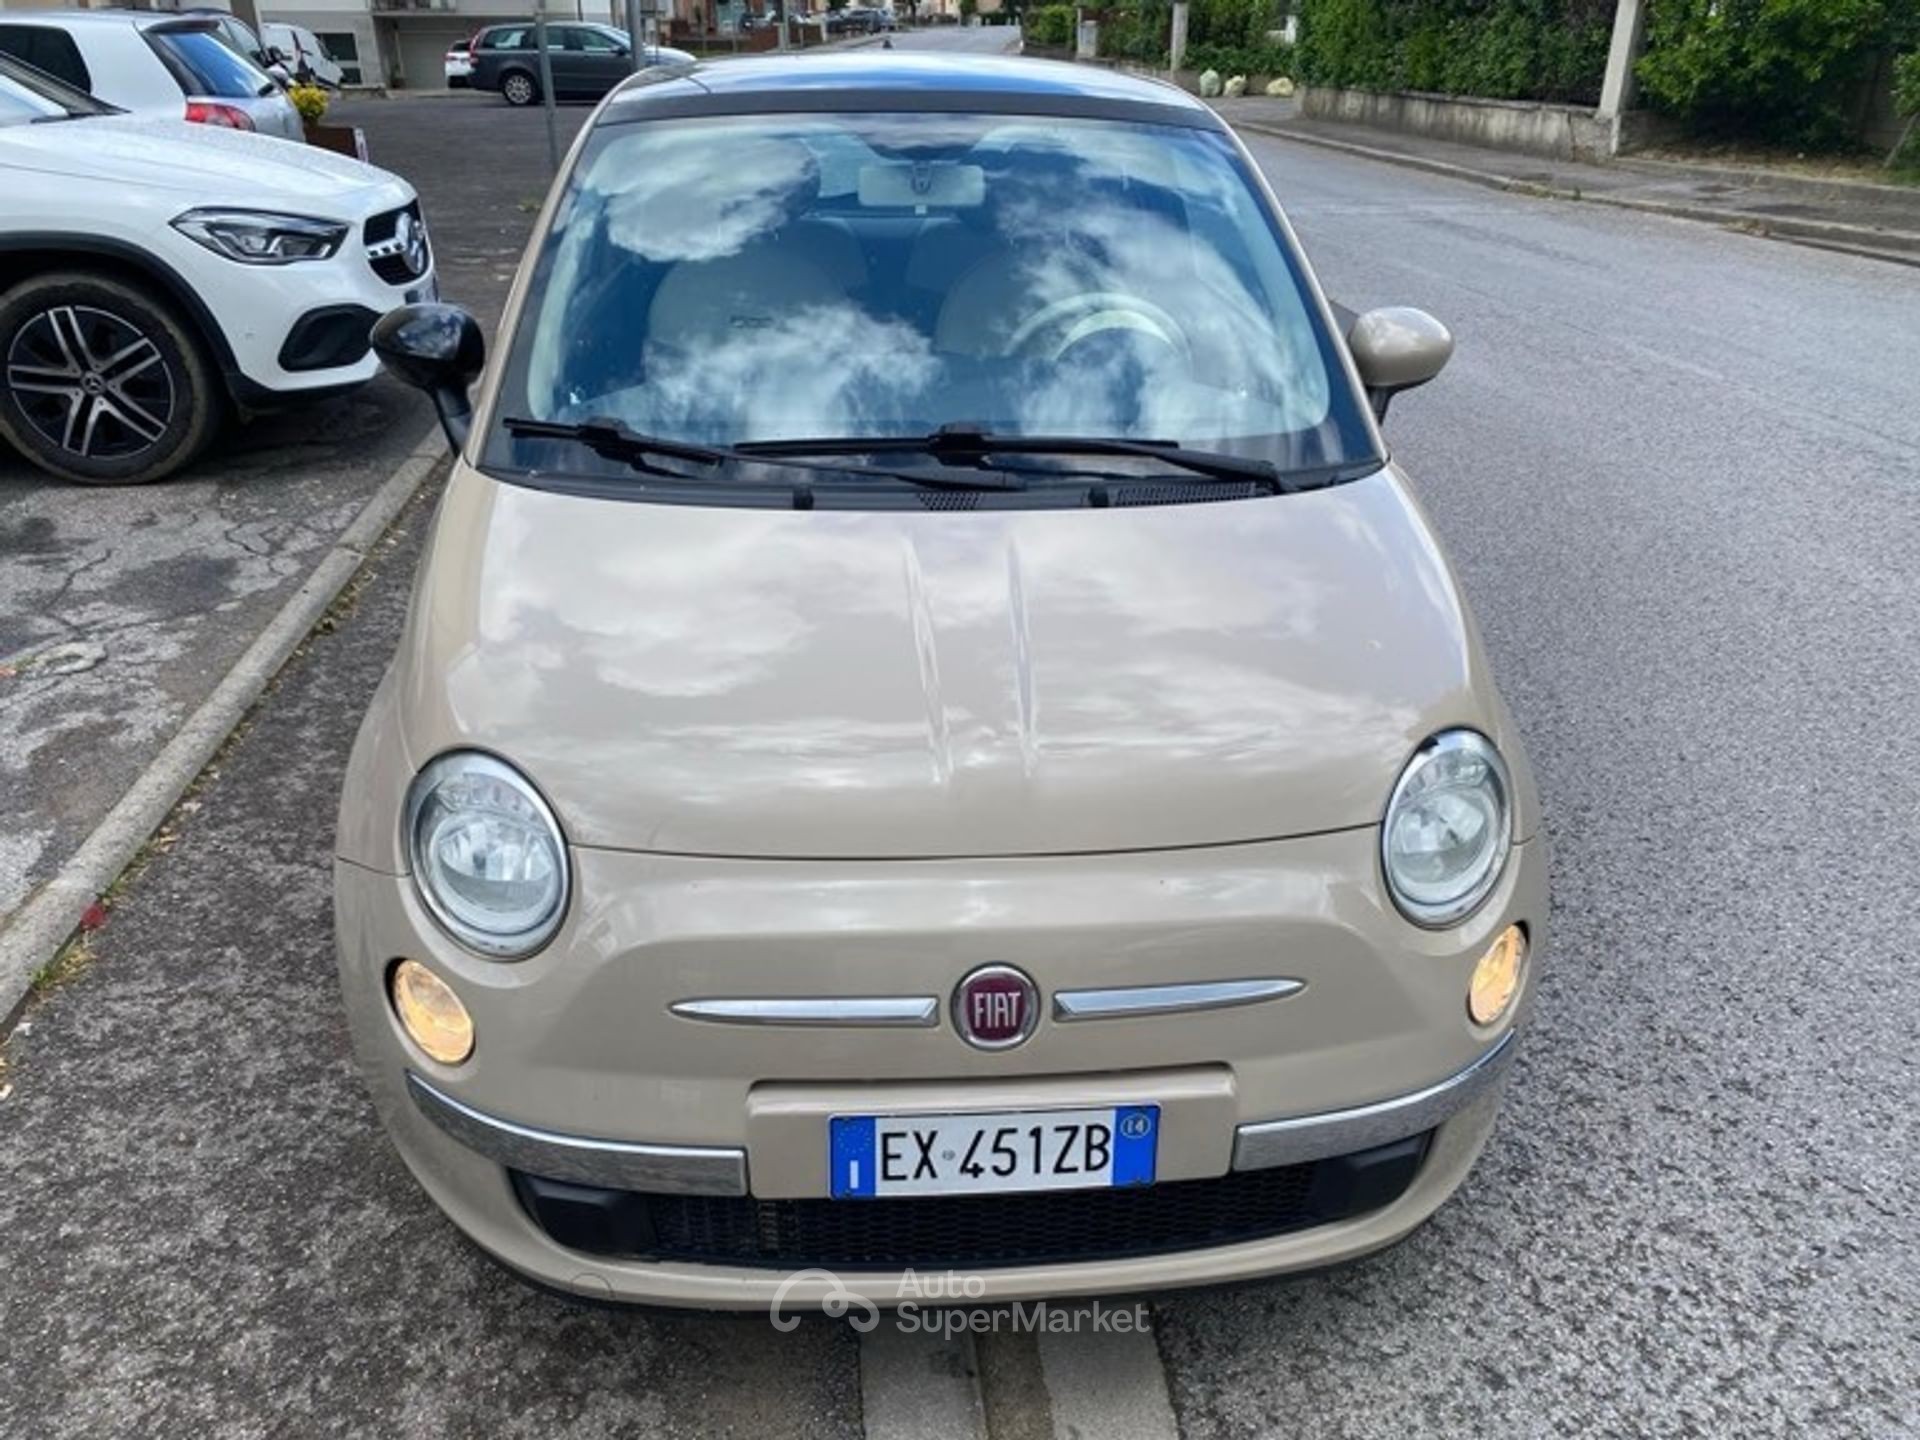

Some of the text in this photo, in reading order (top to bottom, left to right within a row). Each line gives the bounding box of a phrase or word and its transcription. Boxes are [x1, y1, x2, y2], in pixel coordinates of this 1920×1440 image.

[973, 992, 1021, 1029] FIAT
[881, 1124, 1112, 1181] EX 451ZB
